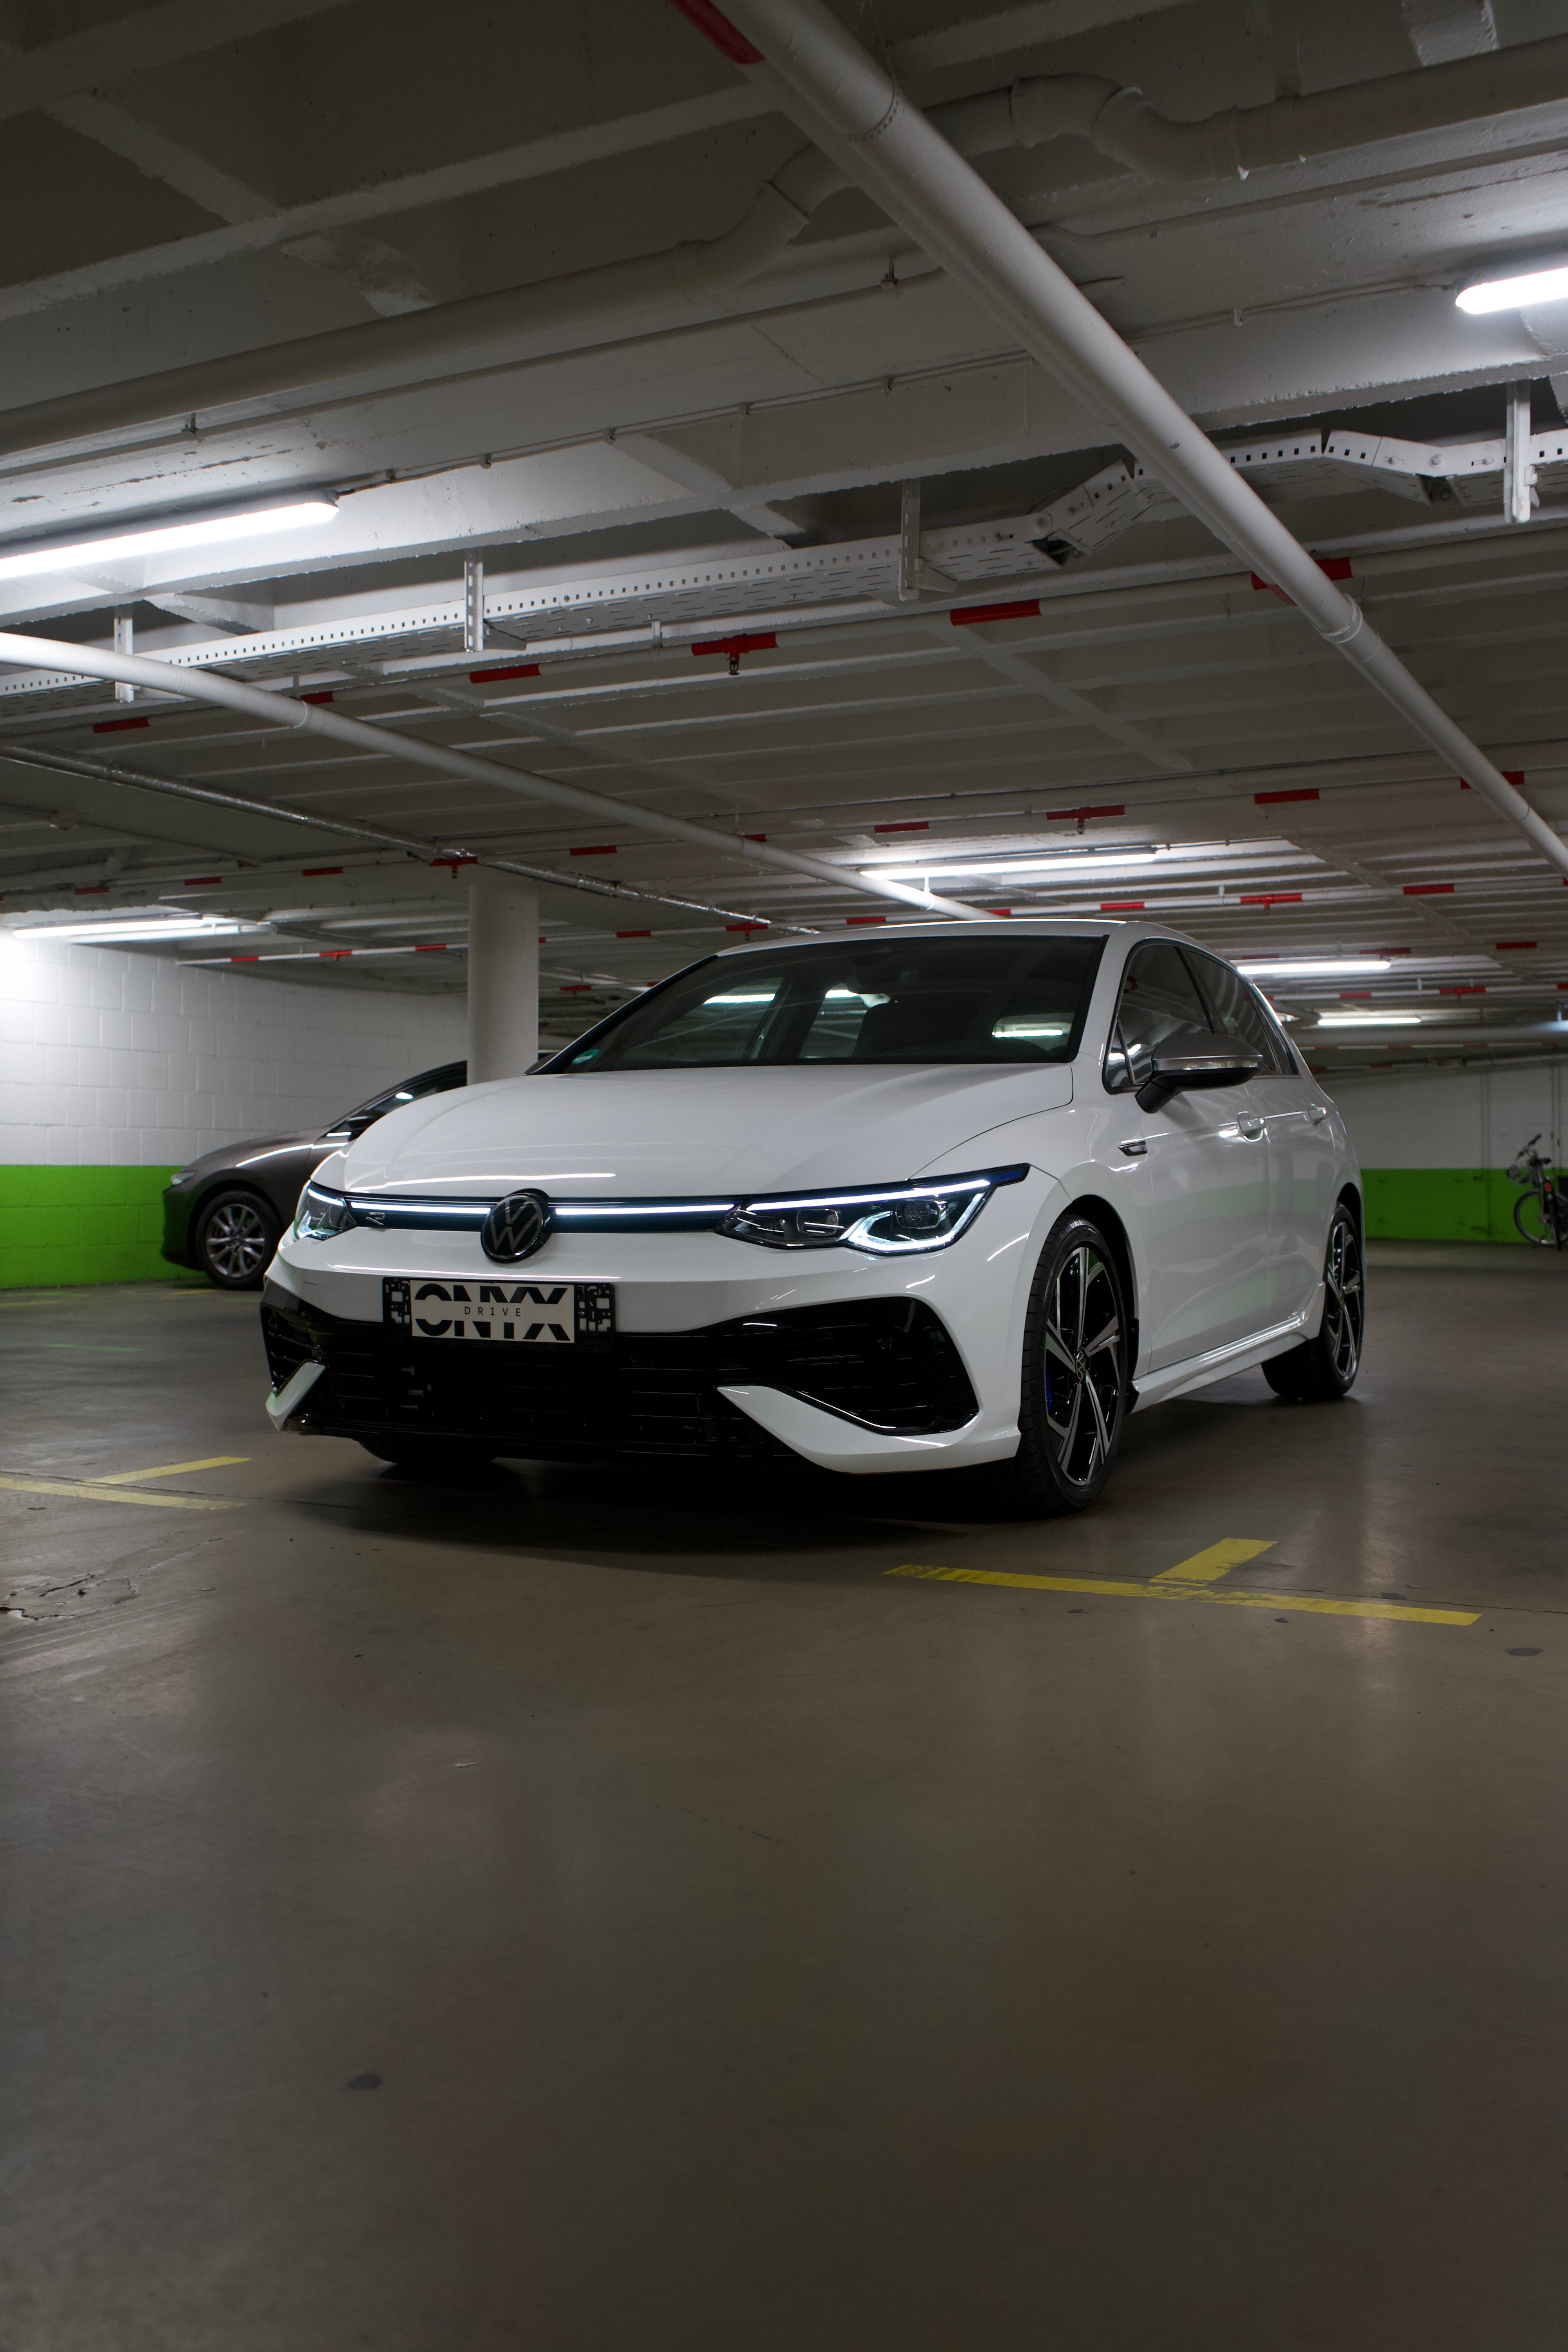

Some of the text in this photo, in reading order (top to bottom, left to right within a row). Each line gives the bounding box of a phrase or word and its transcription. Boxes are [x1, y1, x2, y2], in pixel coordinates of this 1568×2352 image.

[365, 1212, 385, 1225] R
[489, 1196, 540, 1252] VW
[415, 1283, 570, 1341] ONYX
[465, 1307, 521, 1316] DRIVE
